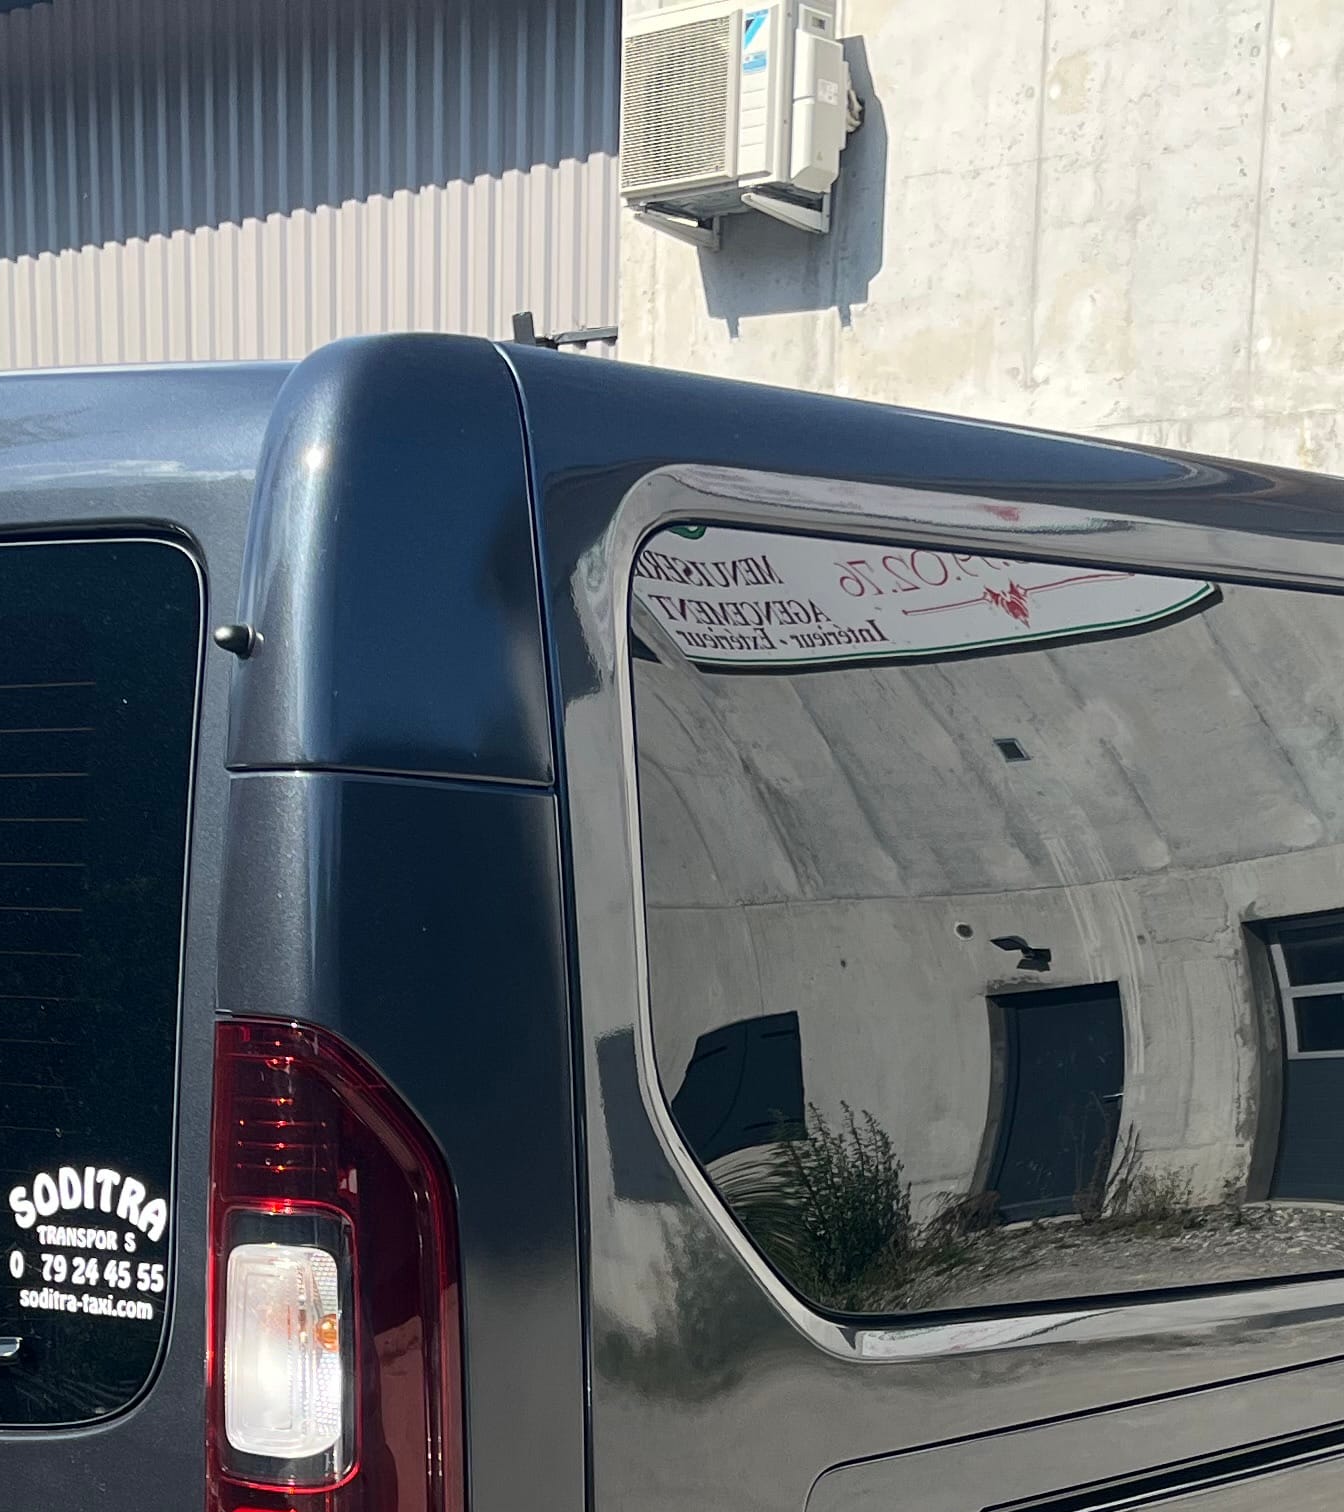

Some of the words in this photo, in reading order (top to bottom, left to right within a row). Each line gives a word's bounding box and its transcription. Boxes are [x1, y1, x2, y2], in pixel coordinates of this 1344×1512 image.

[9, 1166, 167, 1242] SODITRA
[41, 1253, 68, 1283] 79
[71, 1257, 99, 1286] 24
[103, 1259, 131, 1289] 45
[137, 1262, 165, 1292] 55
[19, 1287, 154, 1320] soditra-taxi.com
